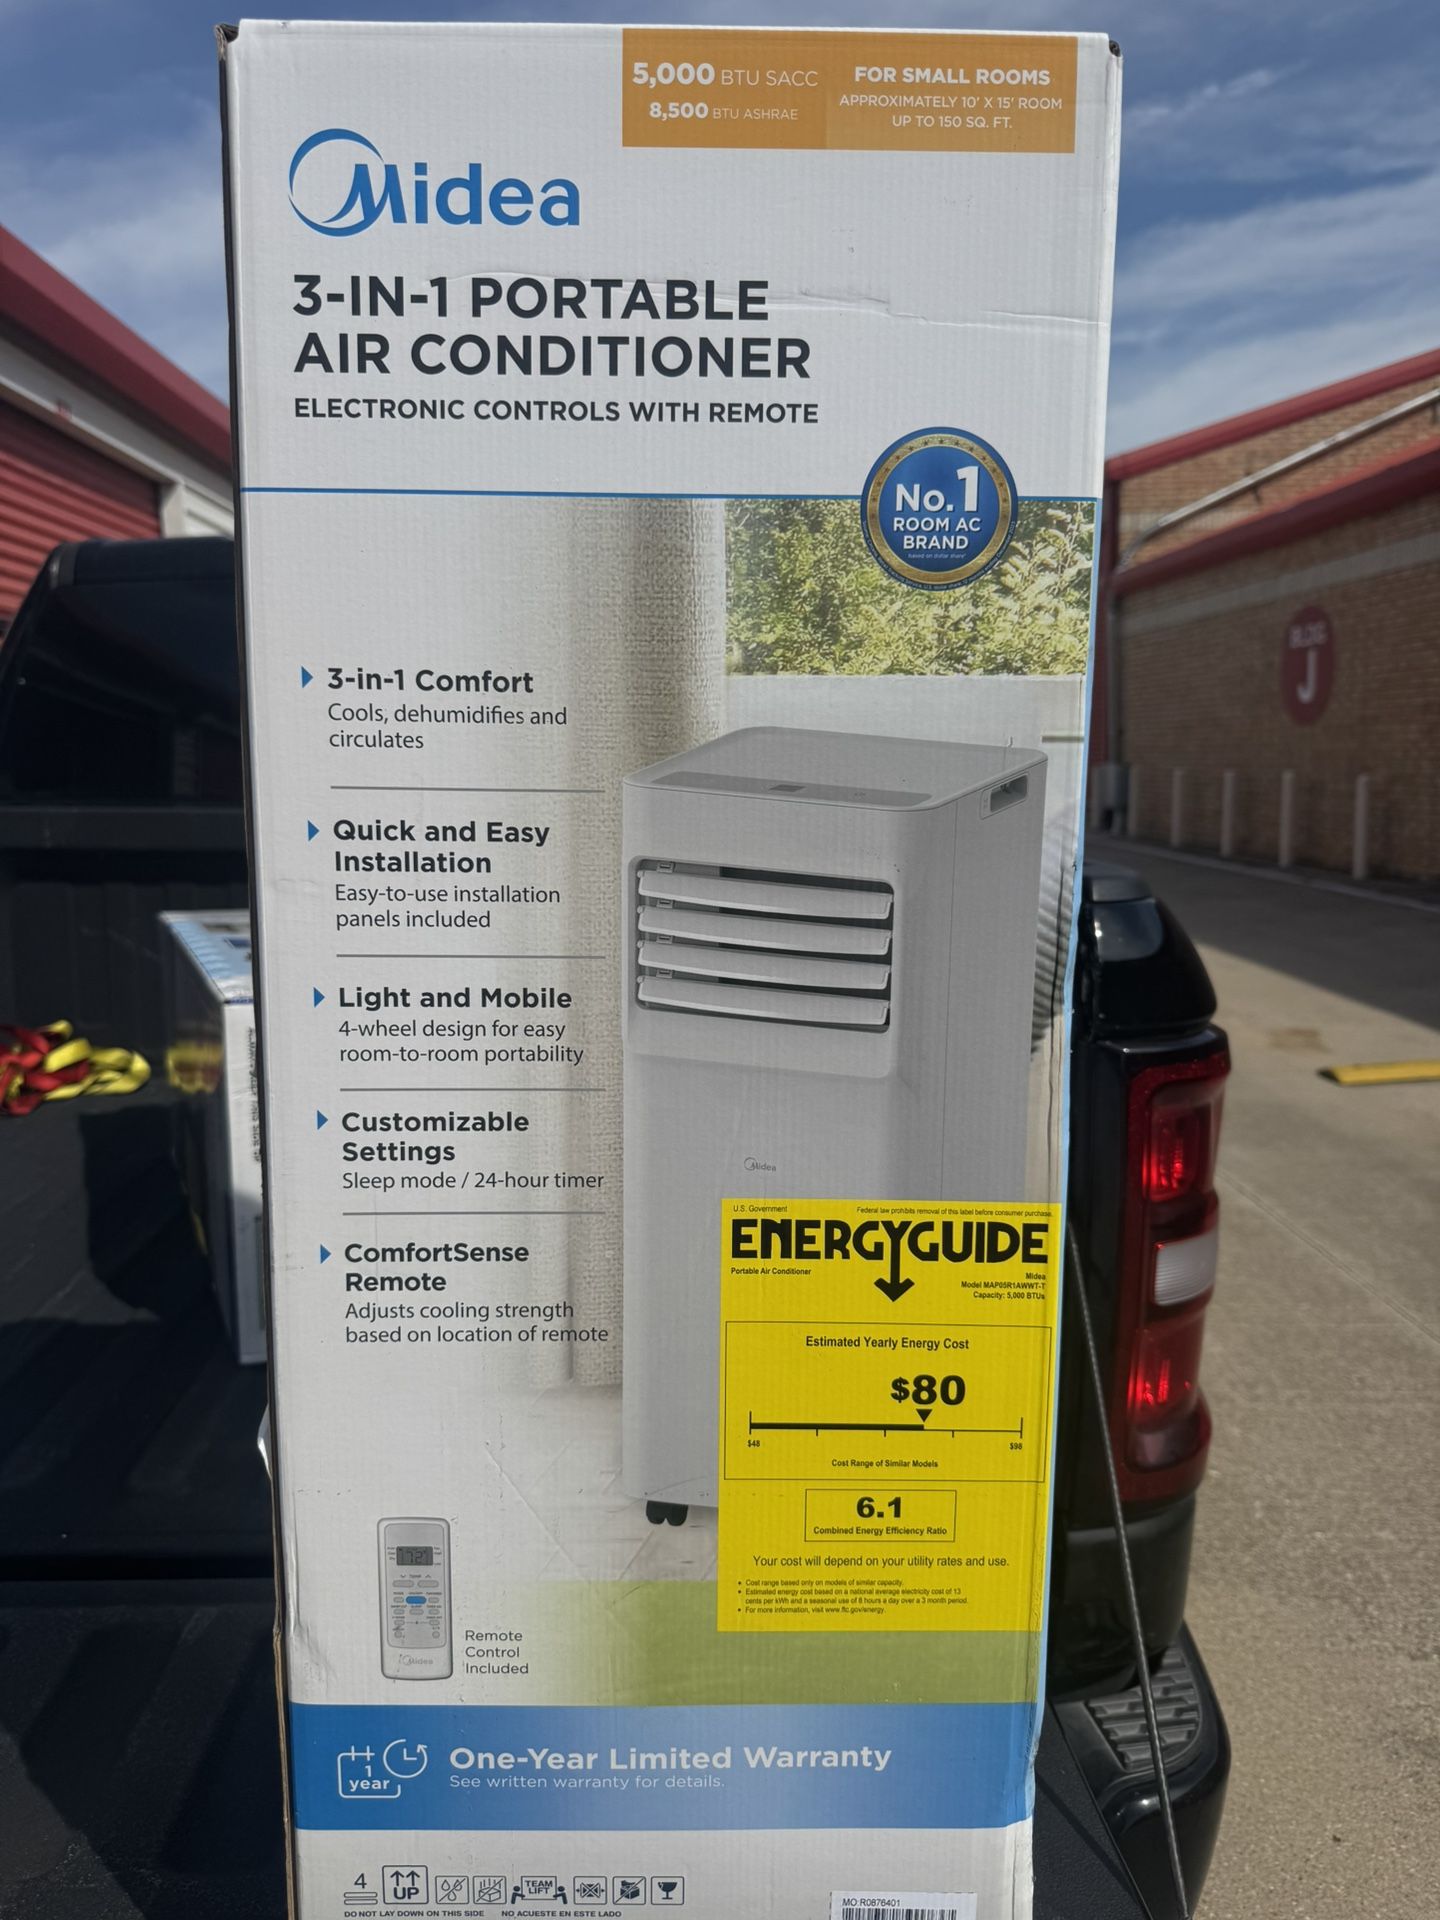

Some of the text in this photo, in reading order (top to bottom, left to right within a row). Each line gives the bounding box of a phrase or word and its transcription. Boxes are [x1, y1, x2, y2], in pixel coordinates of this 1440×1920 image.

[632, 61, 818, 88] 5,000 BTU SACC
[854, 66, 1050, 85] FOR SMALL ROOMS
[649, 101, 797, 120] 8,500 BTU ASHRAE
[839, 94, 1062, 109] APPROXIMATELY 10' X 15' ROOM
[892, 114, 1014, 128] UP TO 150 SQ. FT.
[300, 148, 580, 229] Midea
[293, 274, 768, 320] 3-IN-1 PORTABLE
[294, 331, 810, 378] AIR CONDITIONER
[294, 397, 818, 423] ELECTRONIC CONTROLS WITH REMOTE
[893, 516, 980, 531] ROOM AC
[903, 534, 968, 549] BRAND
[327, 666, 533, 693] 3-in-1 Comfort
[1296, 648, 1318, 704] J
[327, 702, 567, 725] Cools, dehumidifies and
[329, 729, 424, 749] circulates
[333, 818, 549, 847] Quick and Easy
[335, 850, 491, 873] Installation
[335, 883, 560, 906] Easy-to-use installation
[336, 909, 490, 931] panels included
[339, 986, 572, 1011] Light and Mobile
[338, 1018, 566, 1042] 4-wheel design for easy
[340, 1044, 583, 1066] room-to-room portability
[341, 1111, 529, 1132] Customizable
[342, 1140, 455, 1165] Settings
[745, 1158, 776, 1171] Midea
[342, 1170, 604, 1192] Sleep mode / 24-hour timer
[732, 1204, 787, 1212] U.S. Government
[856, 1206, 879, 1214] Federal
[890, 1207, 915, 1215] prohibits
[916, 1207, 940, 1215] removal
[940, 1207, 947, 1215] of
[974, 1208, 993, 1216] before
[1024, 1209, 1052, 1218] purchase.
[344, 1241, 529, 1263] ComfortSense
[732, 1218, 1048, 1269] ENERGYGUIDE
[345, 1272, 446, 1291] Remote
[960, 1280, 982, 1288] Model
[1025, 1271, 1048, 1280] Midea
[972, 1290, 1046, 1300] Capacity: 5,000 BTUs
[345, 1300, 574, 1323] Adjusts cooling strength
[345, 1324, 608, 1343] based on location of remote
[805, 1335, 969, 1351] Estimated Yearly Energy Cost
[890, 1374, 965, 1405] $80
[747, 1439, 760, 1448] $48
[1009, 1441, 1023, 1450] $98
[831, 1458, 938, 1469] Cost Range of Similar Models
[856, 1496, 901, 1518] 6.1
[813, 1525, 947, 1536] Combined Energy Efficiency Ratio
[752, 1554, 1009, 1569] Your cost will depend on your utility rates and use.
[465, 1629, 523, 1642] Remote
[464, 1646, 519, 1658] Control
[465, 1662, 529, 1674] Included
[449, 1746, 891, 1771] One-Year Limited Warranty
[365, 1765, 372, 1777] 1
[349, 1779, 390, 1792] year
[449, 1774, 724, 1790] See written warranty for details.
[393, 1885, 419, 1900] UP
[524, 1880, 553, 1889] TEAM
[528, 1886, 549, 1894] LIFT
[343, 1910, 357, 1918] DO
[501, 1910, 516, 1919] NO
